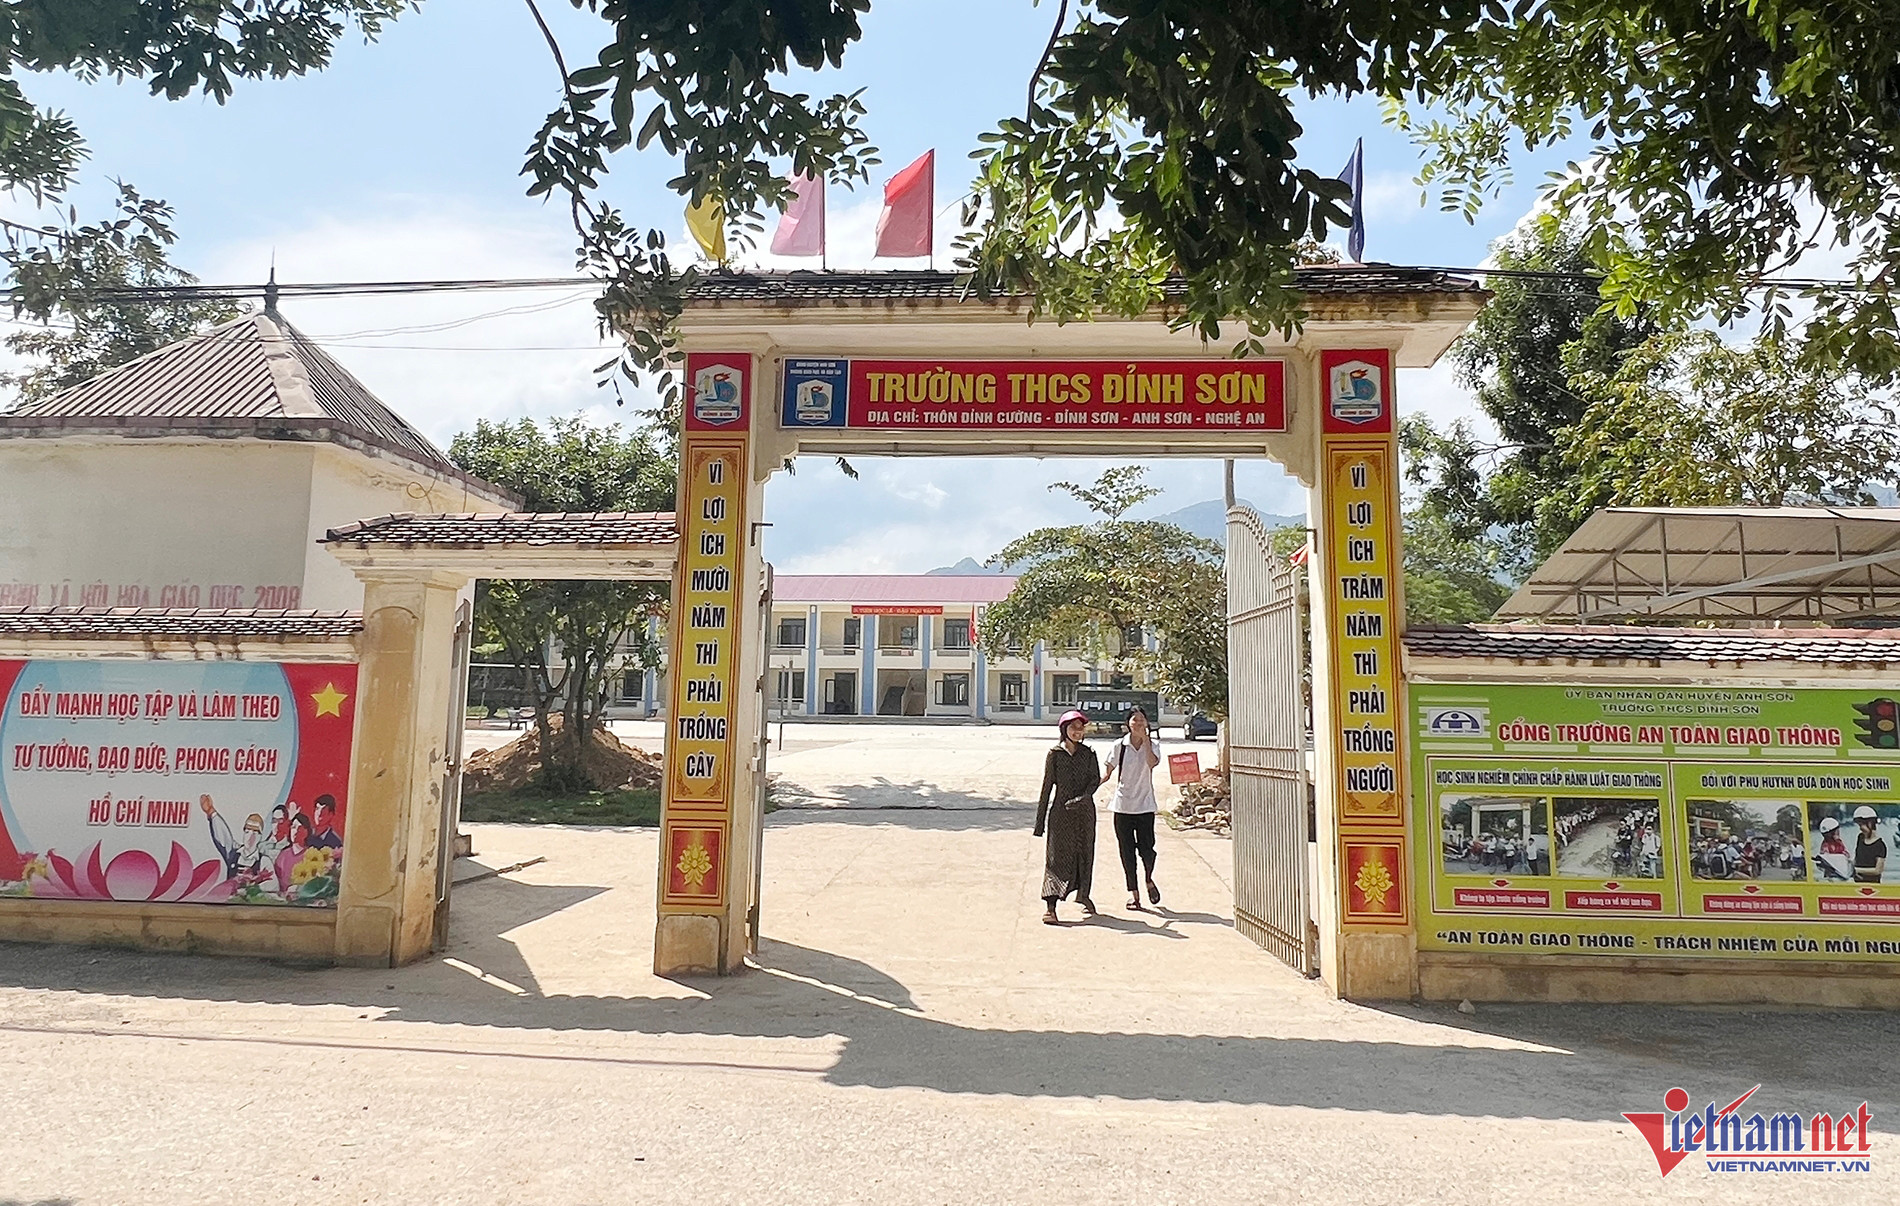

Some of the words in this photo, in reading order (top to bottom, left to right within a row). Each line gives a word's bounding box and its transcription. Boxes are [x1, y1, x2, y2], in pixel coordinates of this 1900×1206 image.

[866, 366, 997, 403] TRƯỜNG
[1008, 373, 1091, 404] THCS
[1102, 364, 1184, 404] ĐỈNH
[1195, 370, 1266, 404] SƠN
[867, 411, 889, 424] ĐỊA
[893, 408, 919, 423] CHỈ:
[923, 409, 958, 423] THÔN
[997, 408, 1042, 424] CƯỜNG
[1091, 411, 1119, 424] SƠN
[1132, 412, 1160, 424] ANH
[1164, 411, 1192, 424] SƠN
[1205, 410, 1241, 427] NGHỆ
[1245, 412, 1265, 424] AN
[709, 459, 722, 483] VÌ
[1351, 463, 1365, 487] VÌ
[703, 497, 725, 524] LỢI
[1348, 502, 1371, 529] LỢI
[700, 530, 724, 555] ÍCH
[1348, 536, 1373, 561] ÍCH
[691, 565, 729, 591] MƯỜI
[1341, 573, 1383, 599] TRĂM
[691, 602, 725, 628] NĂM
[1346, 611, 1381, 636] NĂM
[696, 639, 718, 664] THÌ
[1353, 649, 1377, 675] THÌ
[687, 673, 721, 702] PHẢI
[1350, 684, 1384, 713] PHẢI
[1586, 691, 1612, 699] BAN
[20, 684, 50, 716] ĐẨY
[55, 692, 102, 722] MẠNH
[107, 692, 140, 723] HỌC
[145, 690, 174, 723] TẬP
[178, 689, 198, 718] VÀ
[202, 690, 237, 719] LÀM
[242, 694, 280, 719] THEO
[1660, 704, 1693, 713] THCS
[1344, 722, 1394, 751] TRỒNG
[1499, 717, 1550, 741] CỔNG
[1556, 720, 1631, 742] TRƯỜNG
[1638, 727, 1663, 743] AN
[1670, 723, 1720, 744] TOÀN
[1727, 727, 1770, 745] GIAO
[1777, 724, 1840, 746] THÔNG
[13, 742, 36, 769] TƯ
[38, 738, 92, 774] TƯỞNG,
[98, 746, 130, 777] ĐẠO
[134, 741, 170, 775] ĐỨC,
[175, 747, 230, 773] PHONG
[234, 744, 278, 774] CÁCH
[686, 751, 714, 777] CÂY
[1347, 764, 1393, 791] NGƯỜI
[1436, 771, 1453, 787] HỌC
[1455, 771, 1475, 784] SINH
[1565, 769, 1588, 786] HÀNH
[1612, 774, 1631, 787] GIAO
[1762, 777, 1794, 789] HUYNH
[1843, 778, 1862, 793] HỌC
[1866, 778, 1889, 790] SINH
[87, 791, 111, 825] HỒ
[115, 795, 143, 825] CHÍ
[144, 801, 190, 827] MINH
[1477, 930, 1523, 945] TOÀN
[1529, 934, 1571, 947] GIAO
[1576, 932, 1634, 948] THÔNG
[1654, 933, 1712, 950] TRÁCH
[1718, 936, 1776, 954] NHIỆM
[1783, 934, 1819, 952] CỦA
